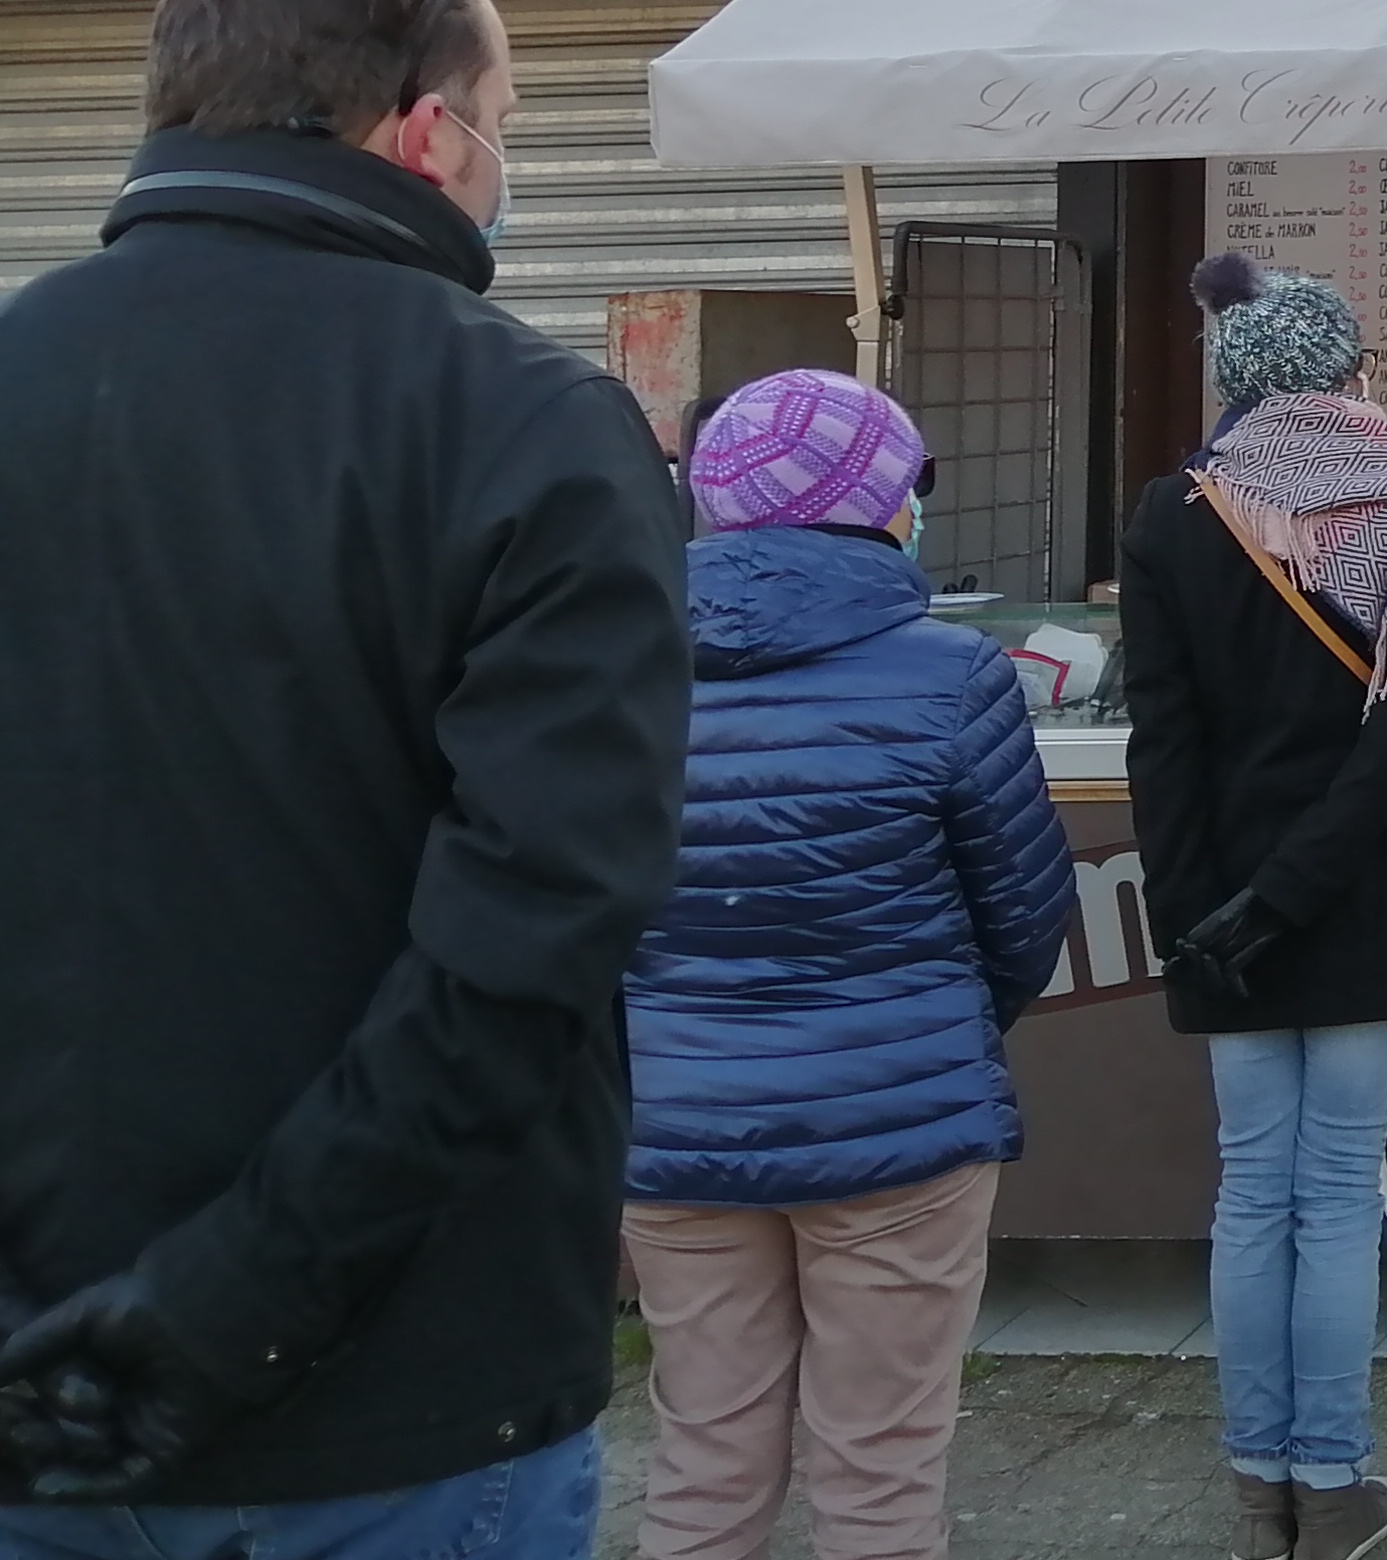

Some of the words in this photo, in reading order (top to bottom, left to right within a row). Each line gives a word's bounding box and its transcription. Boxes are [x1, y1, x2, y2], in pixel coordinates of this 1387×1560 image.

[956, 76, 1051, 132] La
[1077, 72, 1218, 130] Petite
[1226, 203, 1269, 217] CARAMEL
